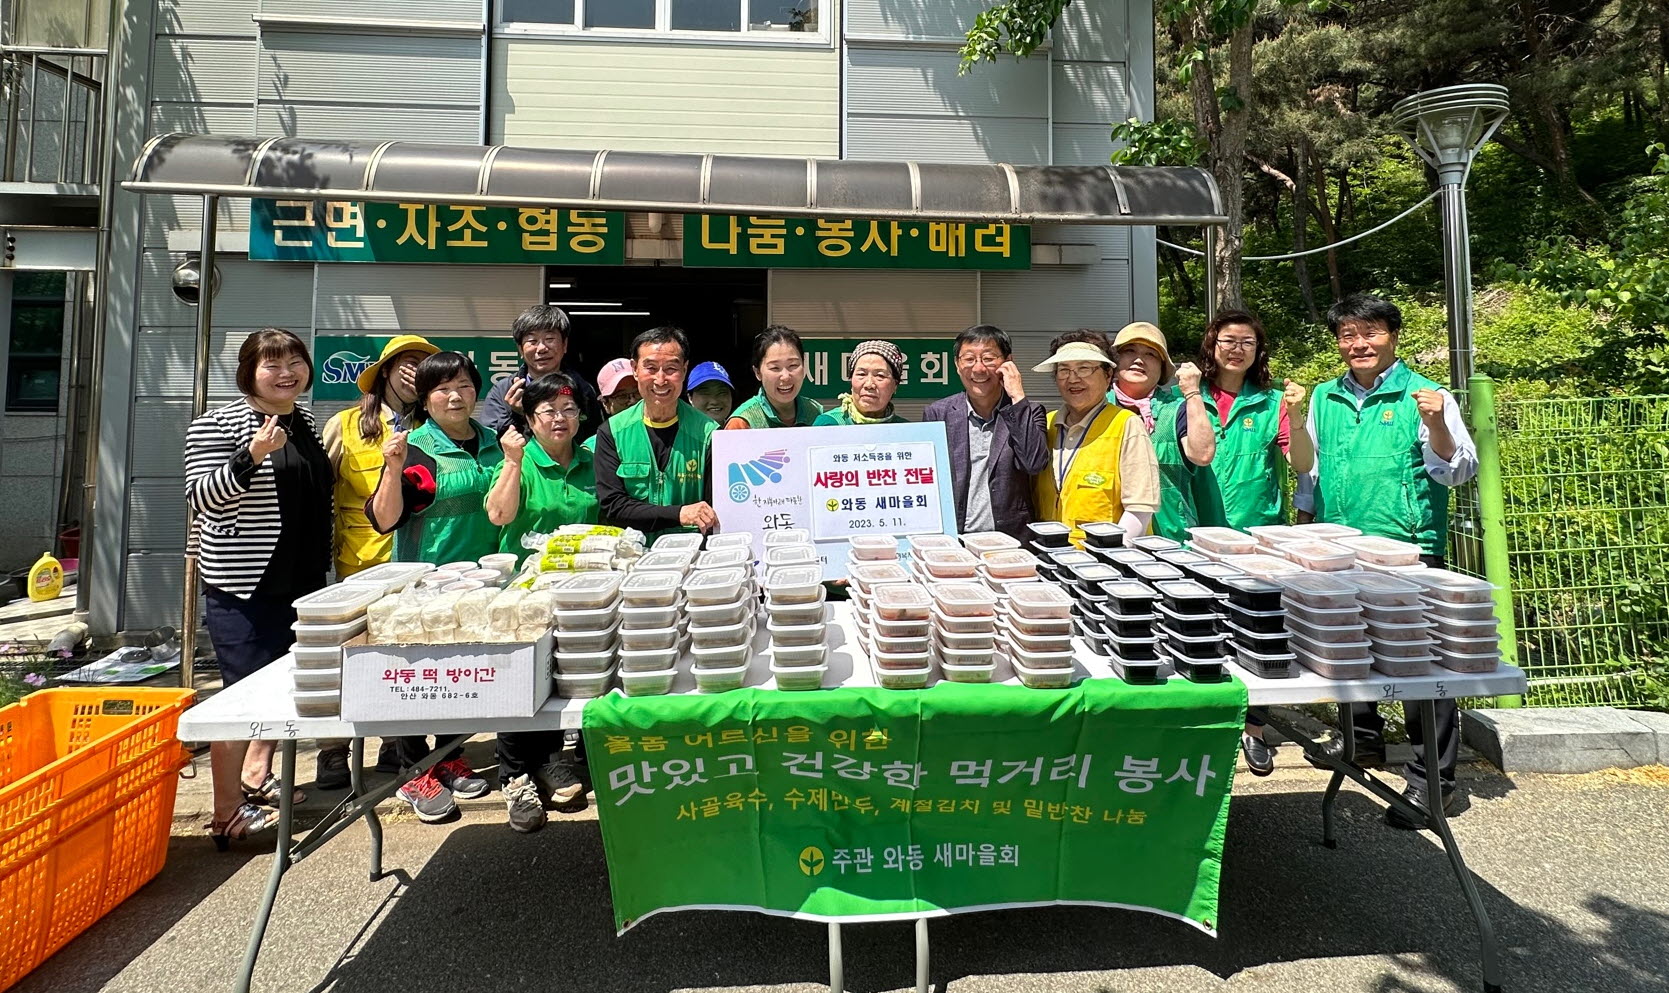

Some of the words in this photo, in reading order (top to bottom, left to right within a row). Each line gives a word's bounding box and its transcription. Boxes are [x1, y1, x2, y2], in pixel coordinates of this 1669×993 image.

[833, 454, 849, 462] 와동
[897, 451, 912, 460] 위한
[814, 470, 859, 488] 사랑의
[866, 469, 897, 486] 반찬
[904, 467, 934, 484] 전달
[841, 498, 867, 511] 와동
[875, 494, 927, 509] 새마을회
[762, 513, 796, 530] 와동
[849, 519, 875, 529] 2023.
[879, 518, 888, 527] 5.
[893, 517, 906, 527] 11.
[382, 668, 416, 684] 와동
[423, 668, 438, 684] 떡
[446, 667, 496, 684] 방아간
[684, 725, 814, 748] 어르신을
[828, 727, 893, 751] 위한
[608, 754, 760, 806] 맛있고
[781, 752, 928, 790] 건강한
[950, 753, 1093, 788] 먹거리
[1114, 754, 1217, 796] 봉사
[676, 787, 774, 820] 사골육수,
[784, 788, 880, 816] 수제만두,
[890, 797, 980, 814] 계절김치
[992, 799, 1012, 815] 및
[1023, 798, 1093, 824] 밑반찬
[1103, 808, 1148, 825] 나눔
[832, 847, 874, 875] 주관
[883, 845, 925, 872] 와동
[934, 842, 1019, 868] 새마을회
